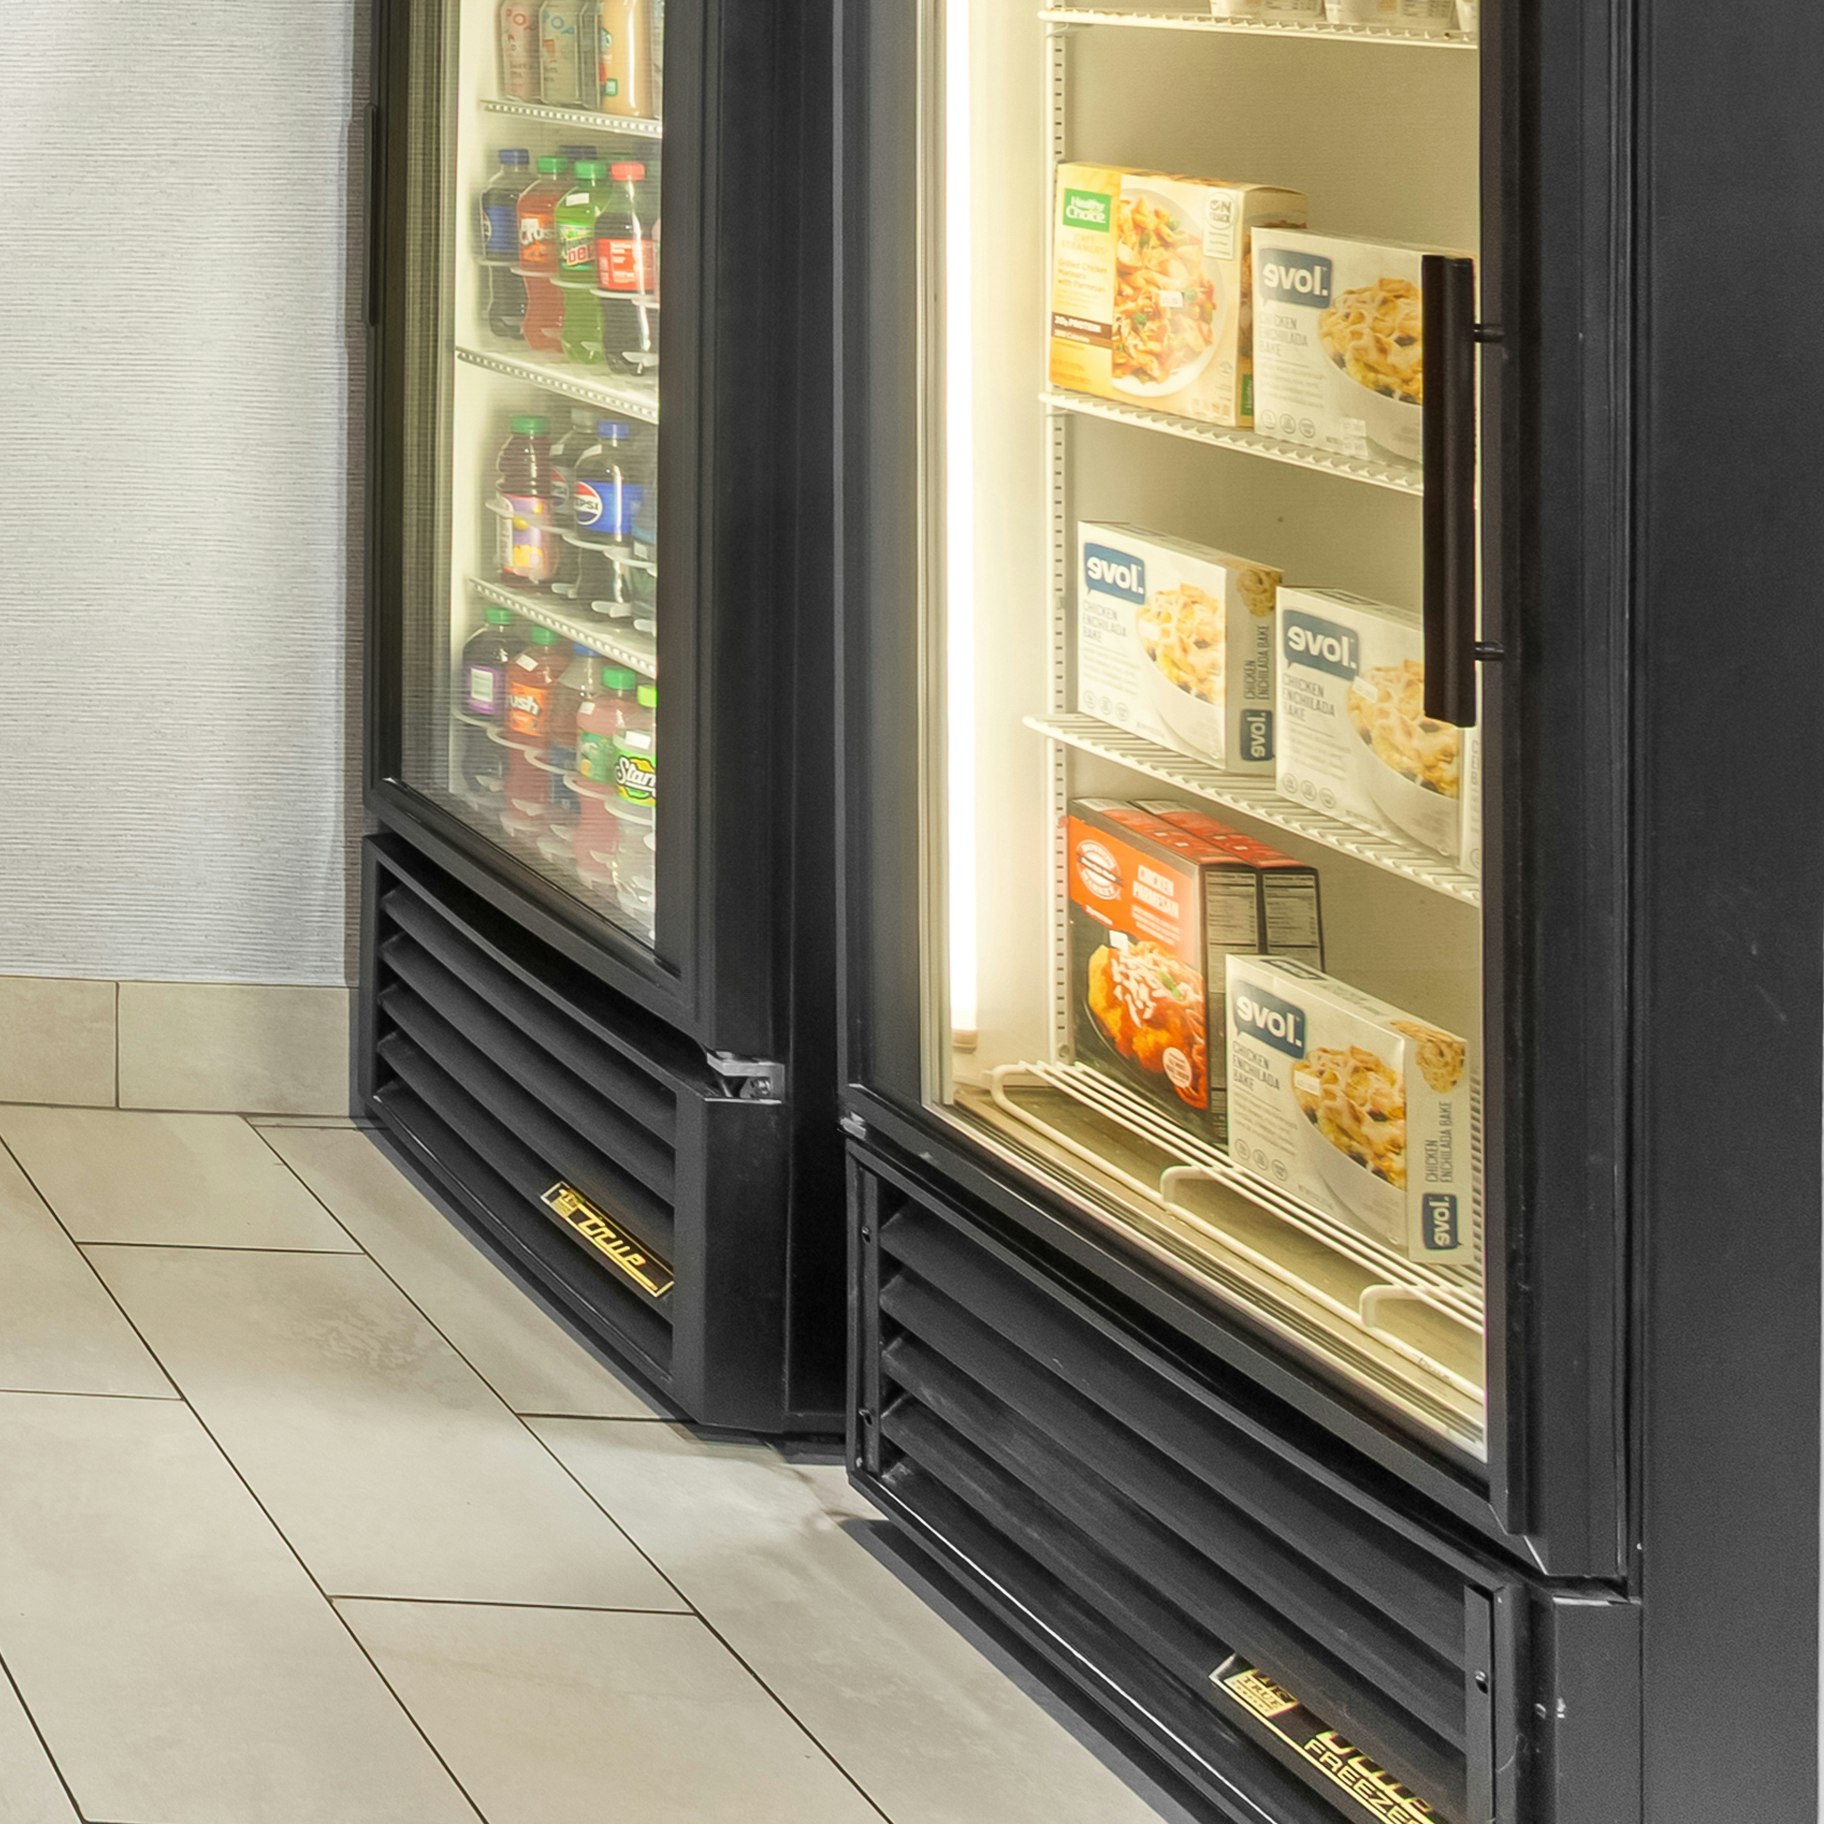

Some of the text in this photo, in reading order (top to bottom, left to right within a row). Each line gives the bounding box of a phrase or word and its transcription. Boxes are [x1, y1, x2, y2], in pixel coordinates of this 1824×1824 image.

[1065, 204, 1106, 224] Choice
[1070, 195, 1105, 213] Healthy
[1232, 1041, 1270, 1070] CHICKEN
[1232, 1054, 1280, 1090] ENCHILADA
[1440, 1101, 1452, 1183] ENCHILADA BAKE
[1426, 1139, 1438, 1183] CHICKEN
